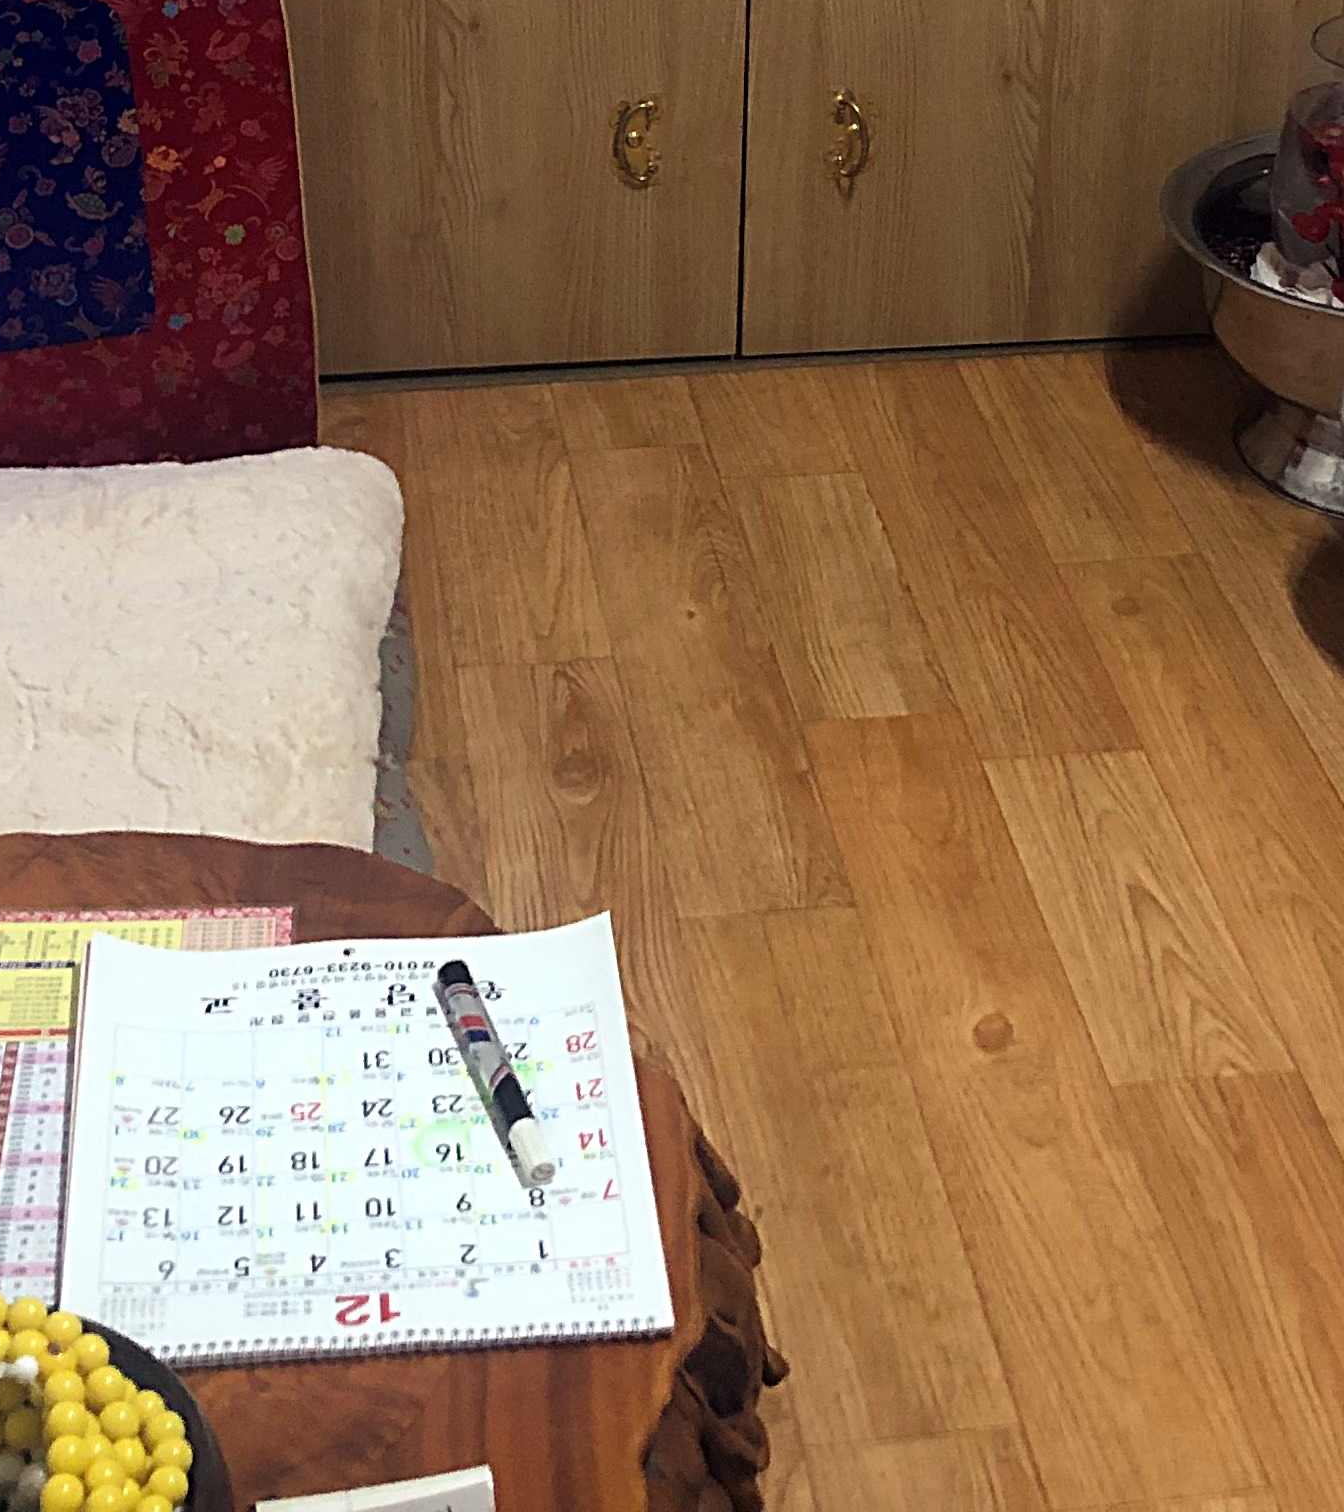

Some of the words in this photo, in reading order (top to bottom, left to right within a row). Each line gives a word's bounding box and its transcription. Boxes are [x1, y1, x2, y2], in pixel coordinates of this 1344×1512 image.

[269, 961, 417, 978] 010-9233-6730
[566, 1030, 596, 1053] 28
[363, 1051, 390, 1069] 31
[429, 1048, 459, 1066] 30
[576, 1078, 603, 1101] 21
[291, 1102, 321, 1121] 25
[362, 1098, 392, 1117] 24
[432, 1094, 464, 1114] 23
[148, 1107, 178, 1125] 27
[219, 1106, 250, 1124] 26
[578, 1129, 607, 1150] 14
[291, 1151, 320, 1171] 18
[364, 1148, 393, 1167] 17
[436, 1143, 464, 1163] 16
[144, 1156, 177, 1176] 20
[218, 1155, 247, 1174] 19
[529, 1188, 544, 1208] 8
[603, 1179, 619, 1200] 7
[296, 1201, 322, 1221] 11
[365, 1198, 396, 1217] 10
[456, 1193, 472, 1213] 9
[143, 1208, 174, 1227] 13
[218, 1206, 247, 1225] 12
[480, 1214, 497, 1225] 12
[385, 1249, 401, 1268] 3
[460, 1244, 476, 1264] 2
[539, 1240, 549, 1259] 1
[158, 1260, 174, 1280] 6
[234, 1257, 250, 1277] 5
[310, 1255, 326, 1273] 4
[335, 1293, 400, 1326] 12
